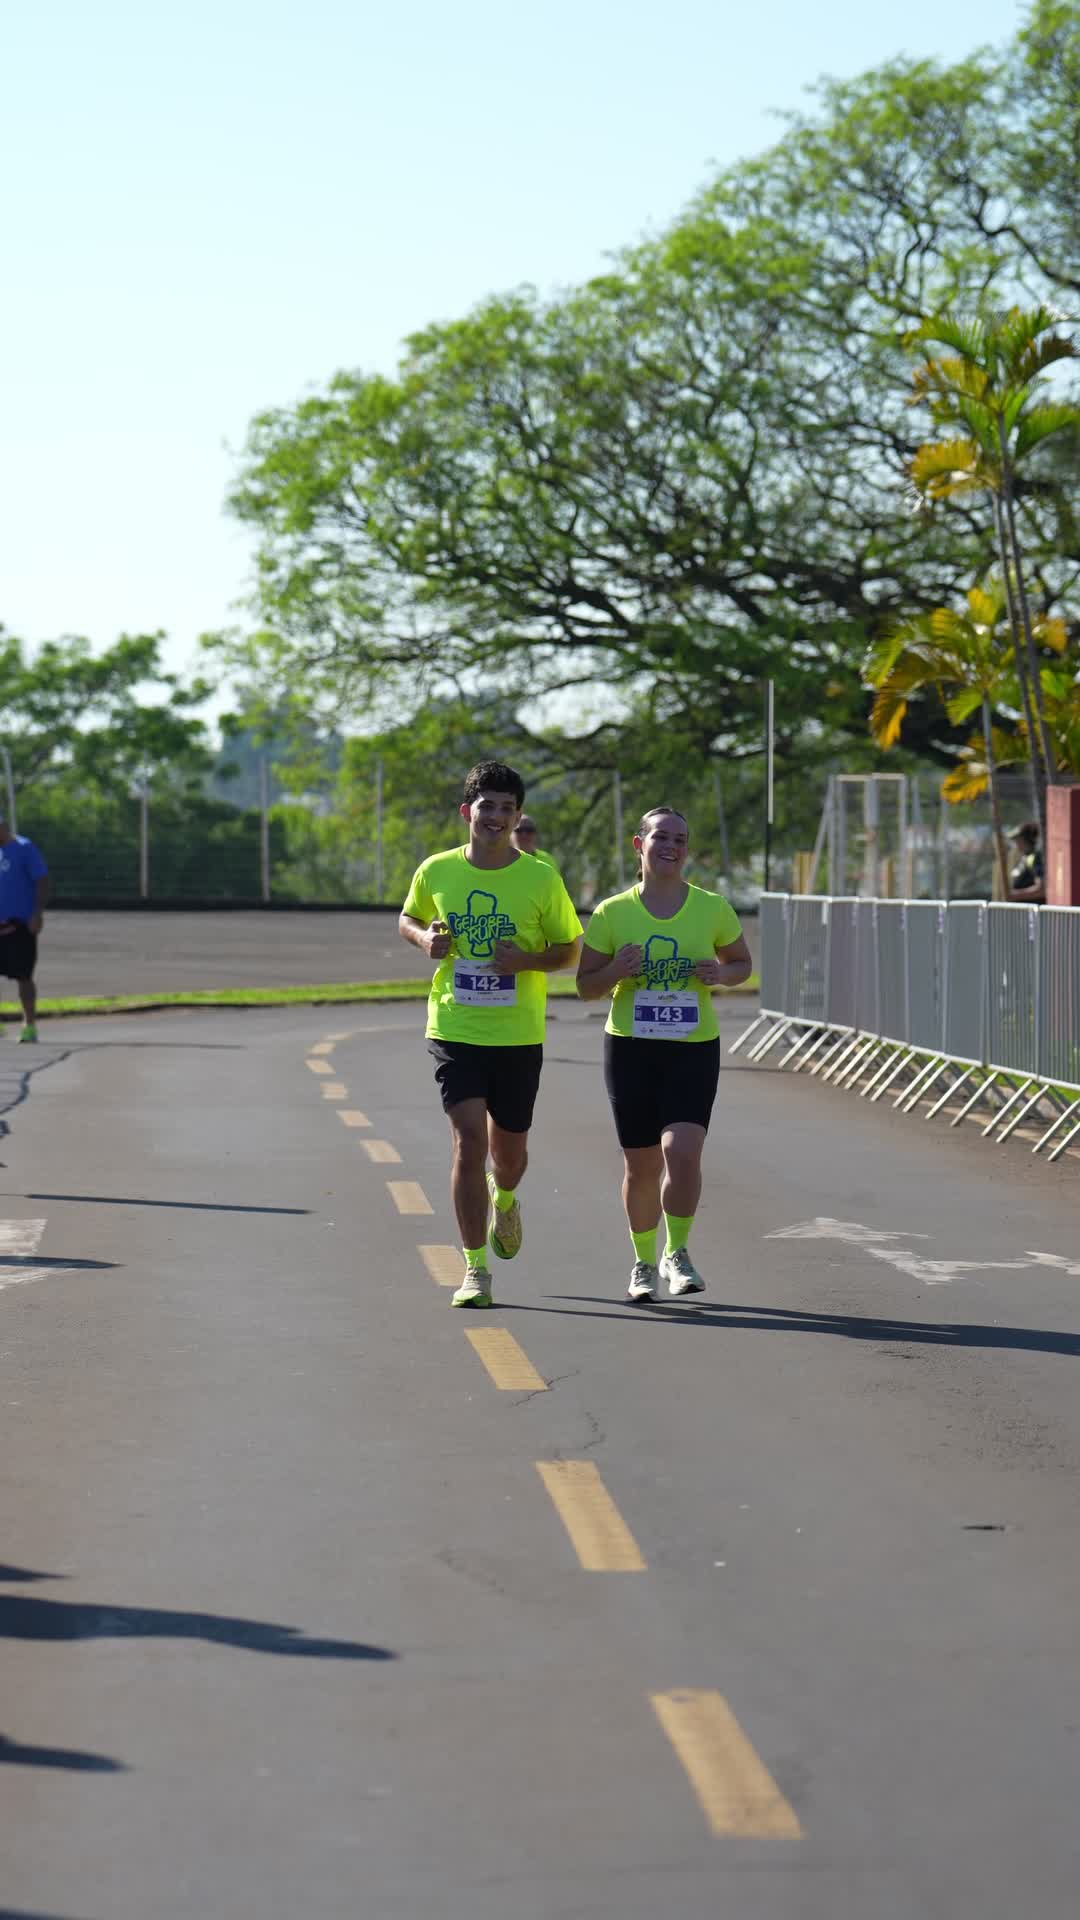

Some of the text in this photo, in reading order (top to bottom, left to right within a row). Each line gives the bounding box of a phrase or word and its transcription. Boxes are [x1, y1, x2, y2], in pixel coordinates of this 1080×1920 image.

[454, 915, 514, 932] GELOBEL
[467, 925, 499, 944] RUN
[640, 959, 694, 974] ELOBEL
[470, 976, 501, 991] 142
[647, 967, 680, 984] RUN
[652, 1007, 683, 1022] 143
